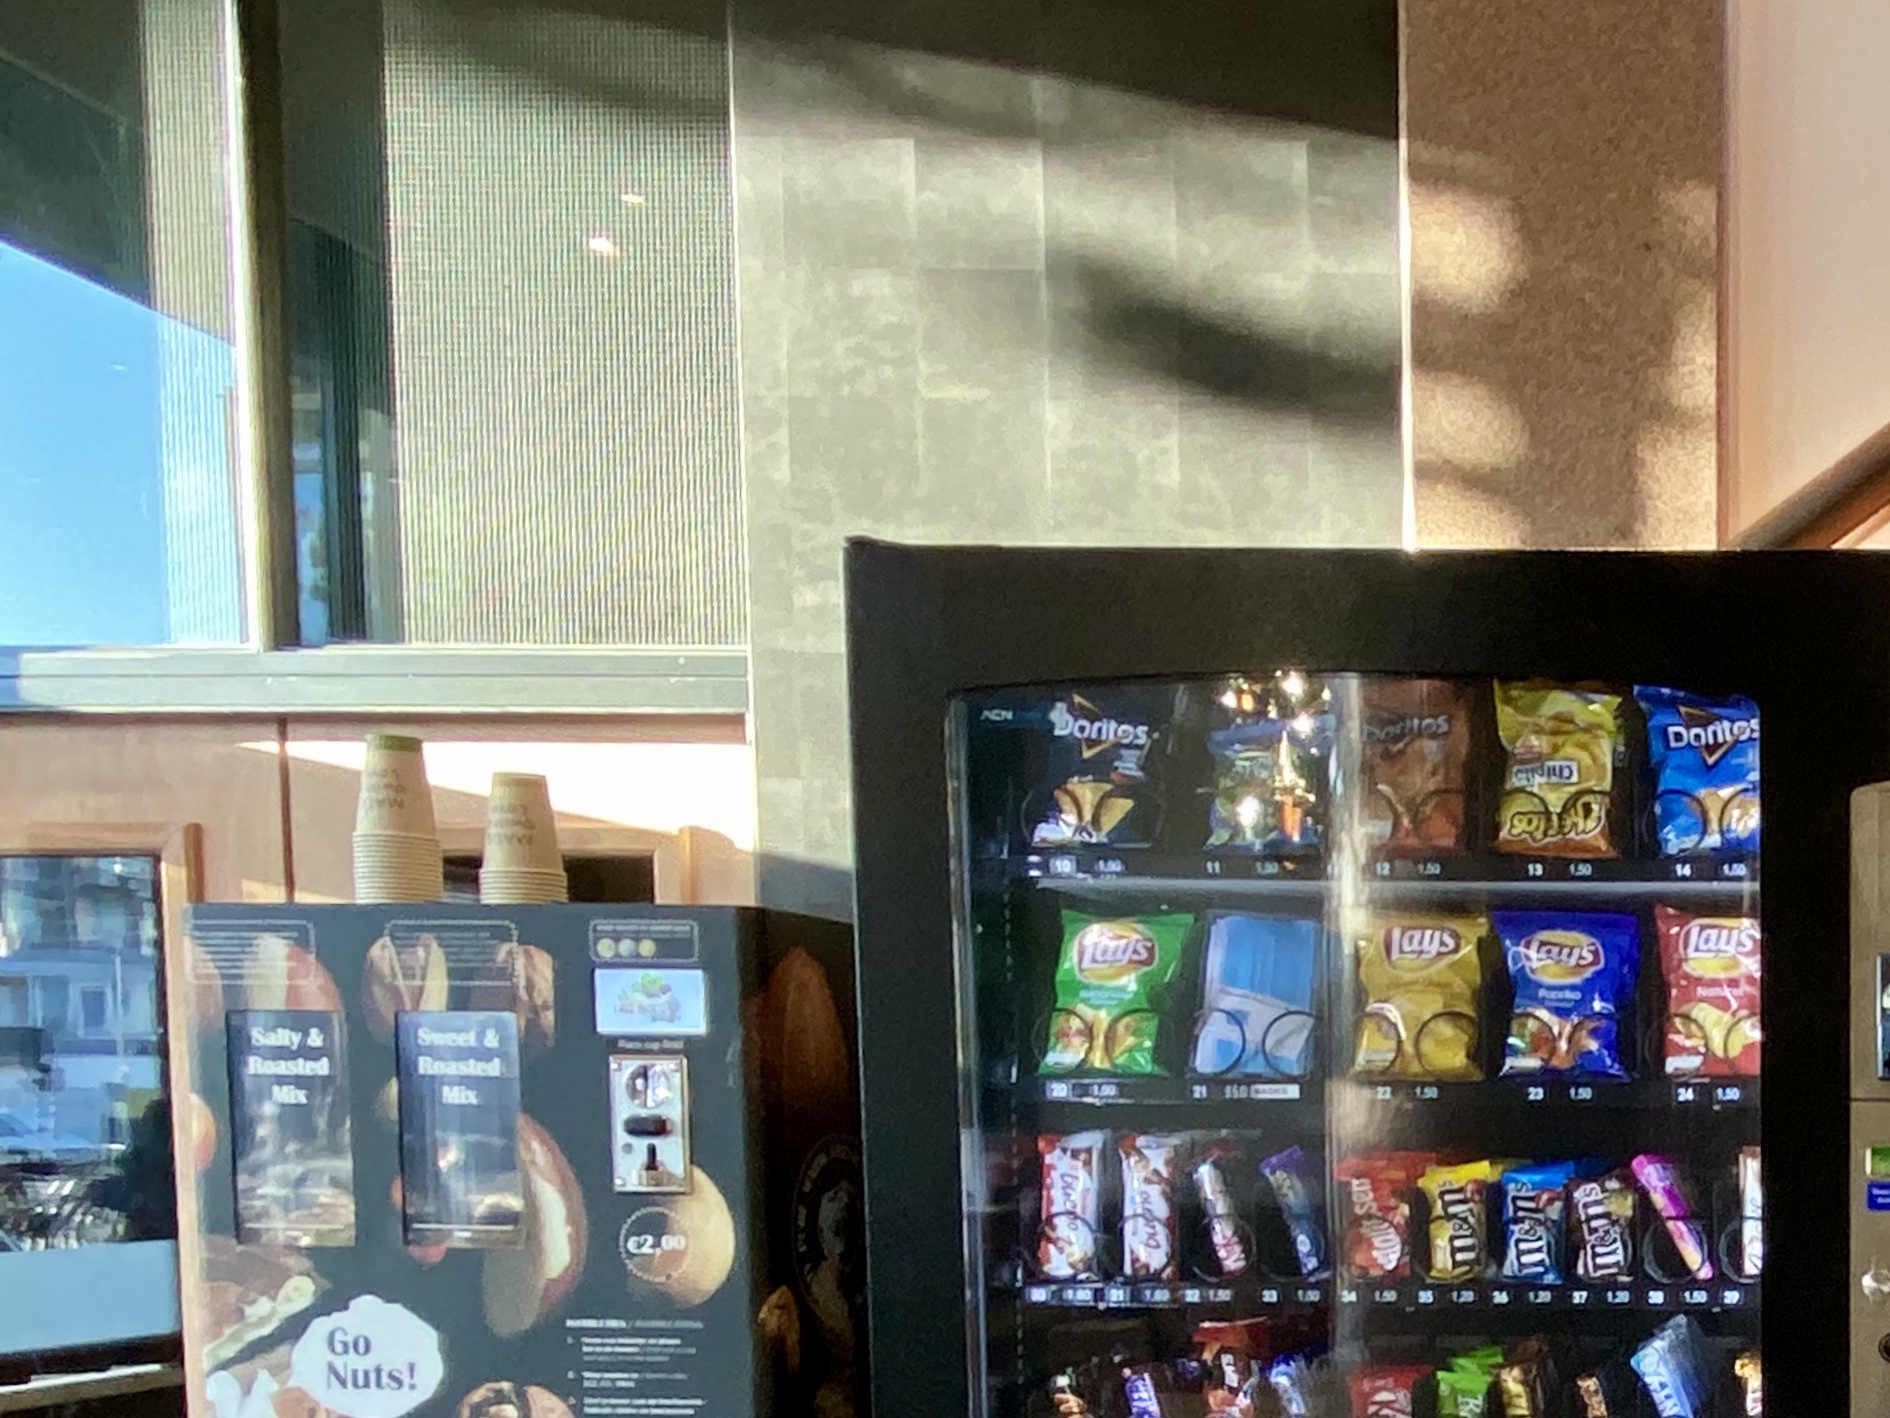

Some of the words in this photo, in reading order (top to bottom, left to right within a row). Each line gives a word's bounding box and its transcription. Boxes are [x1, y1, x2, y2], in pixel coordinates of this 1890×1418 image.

[1051, 704, 1149, 745] Doritos
[1667, 717, 1760, 749] Doritos
[1527, 864, 1543, 876] 13
[1675, 864, 1692, 877] 14
[251, 1026, 302, 1051] Salty
[307, 1028, 324, 1047] &
[417, 1026, 476, 1048] Sweet
[248, 1055, 329, 1077] Roasted
[417, 1055, 501, 1077] Roasted
[271, 1083, 308, 1106] Mix
[441, 1083, 479, 1106] Mix
[326, 1327, 372, 1357] Go
[326, 1361, 418, 1392] Nuts!
